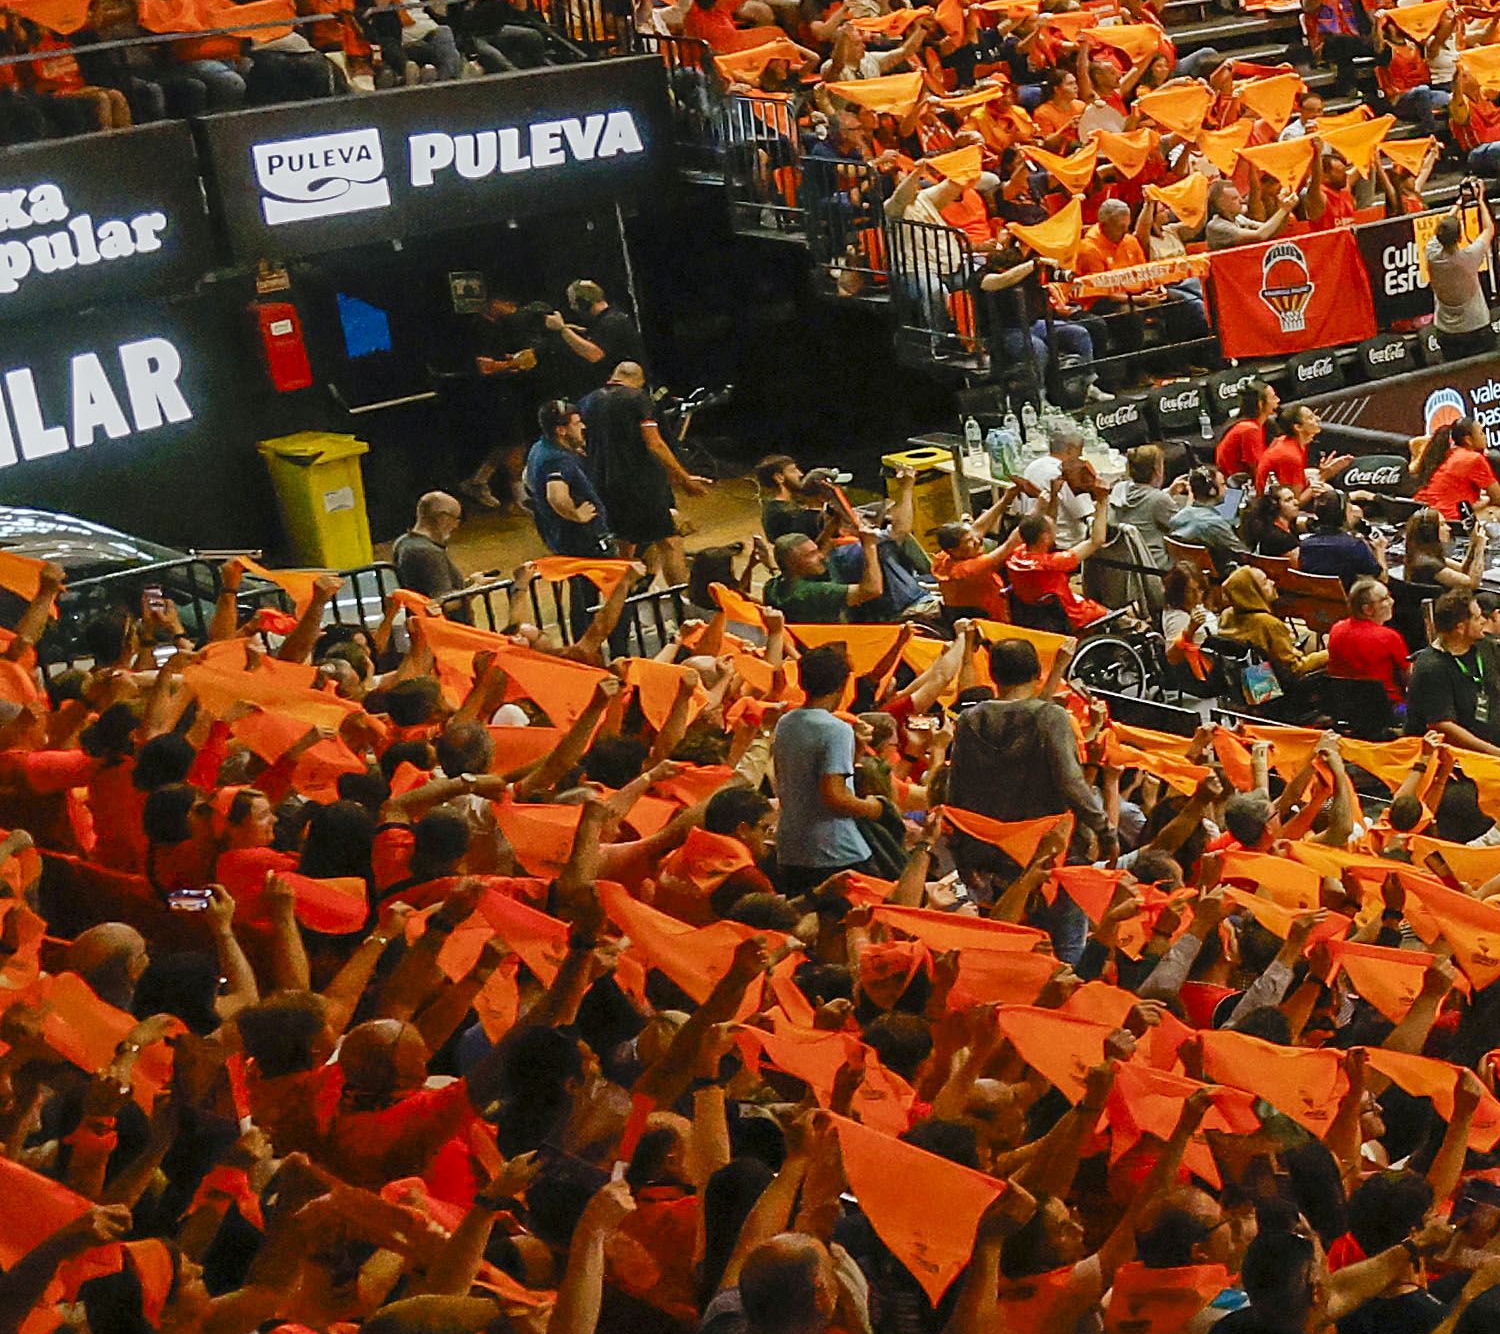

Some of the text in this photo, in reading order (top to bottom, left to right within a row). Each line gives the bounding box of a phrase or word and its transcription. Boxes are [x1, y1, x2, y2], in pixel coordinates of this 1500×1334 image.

[267, 143, 373, 175] PULEVA
[409, 111, 643, 186] PULEVA
[1369, 342, 1404, 364] Coca-Cola
[1298, 357, 1333, 381] Coca-Cola
[1160, 390, 1199, 412] Coca-Cola
[1096, 404, 1137, 430] Coca-Cola
[1345, 466, 1400, 485] Coca-Cola
